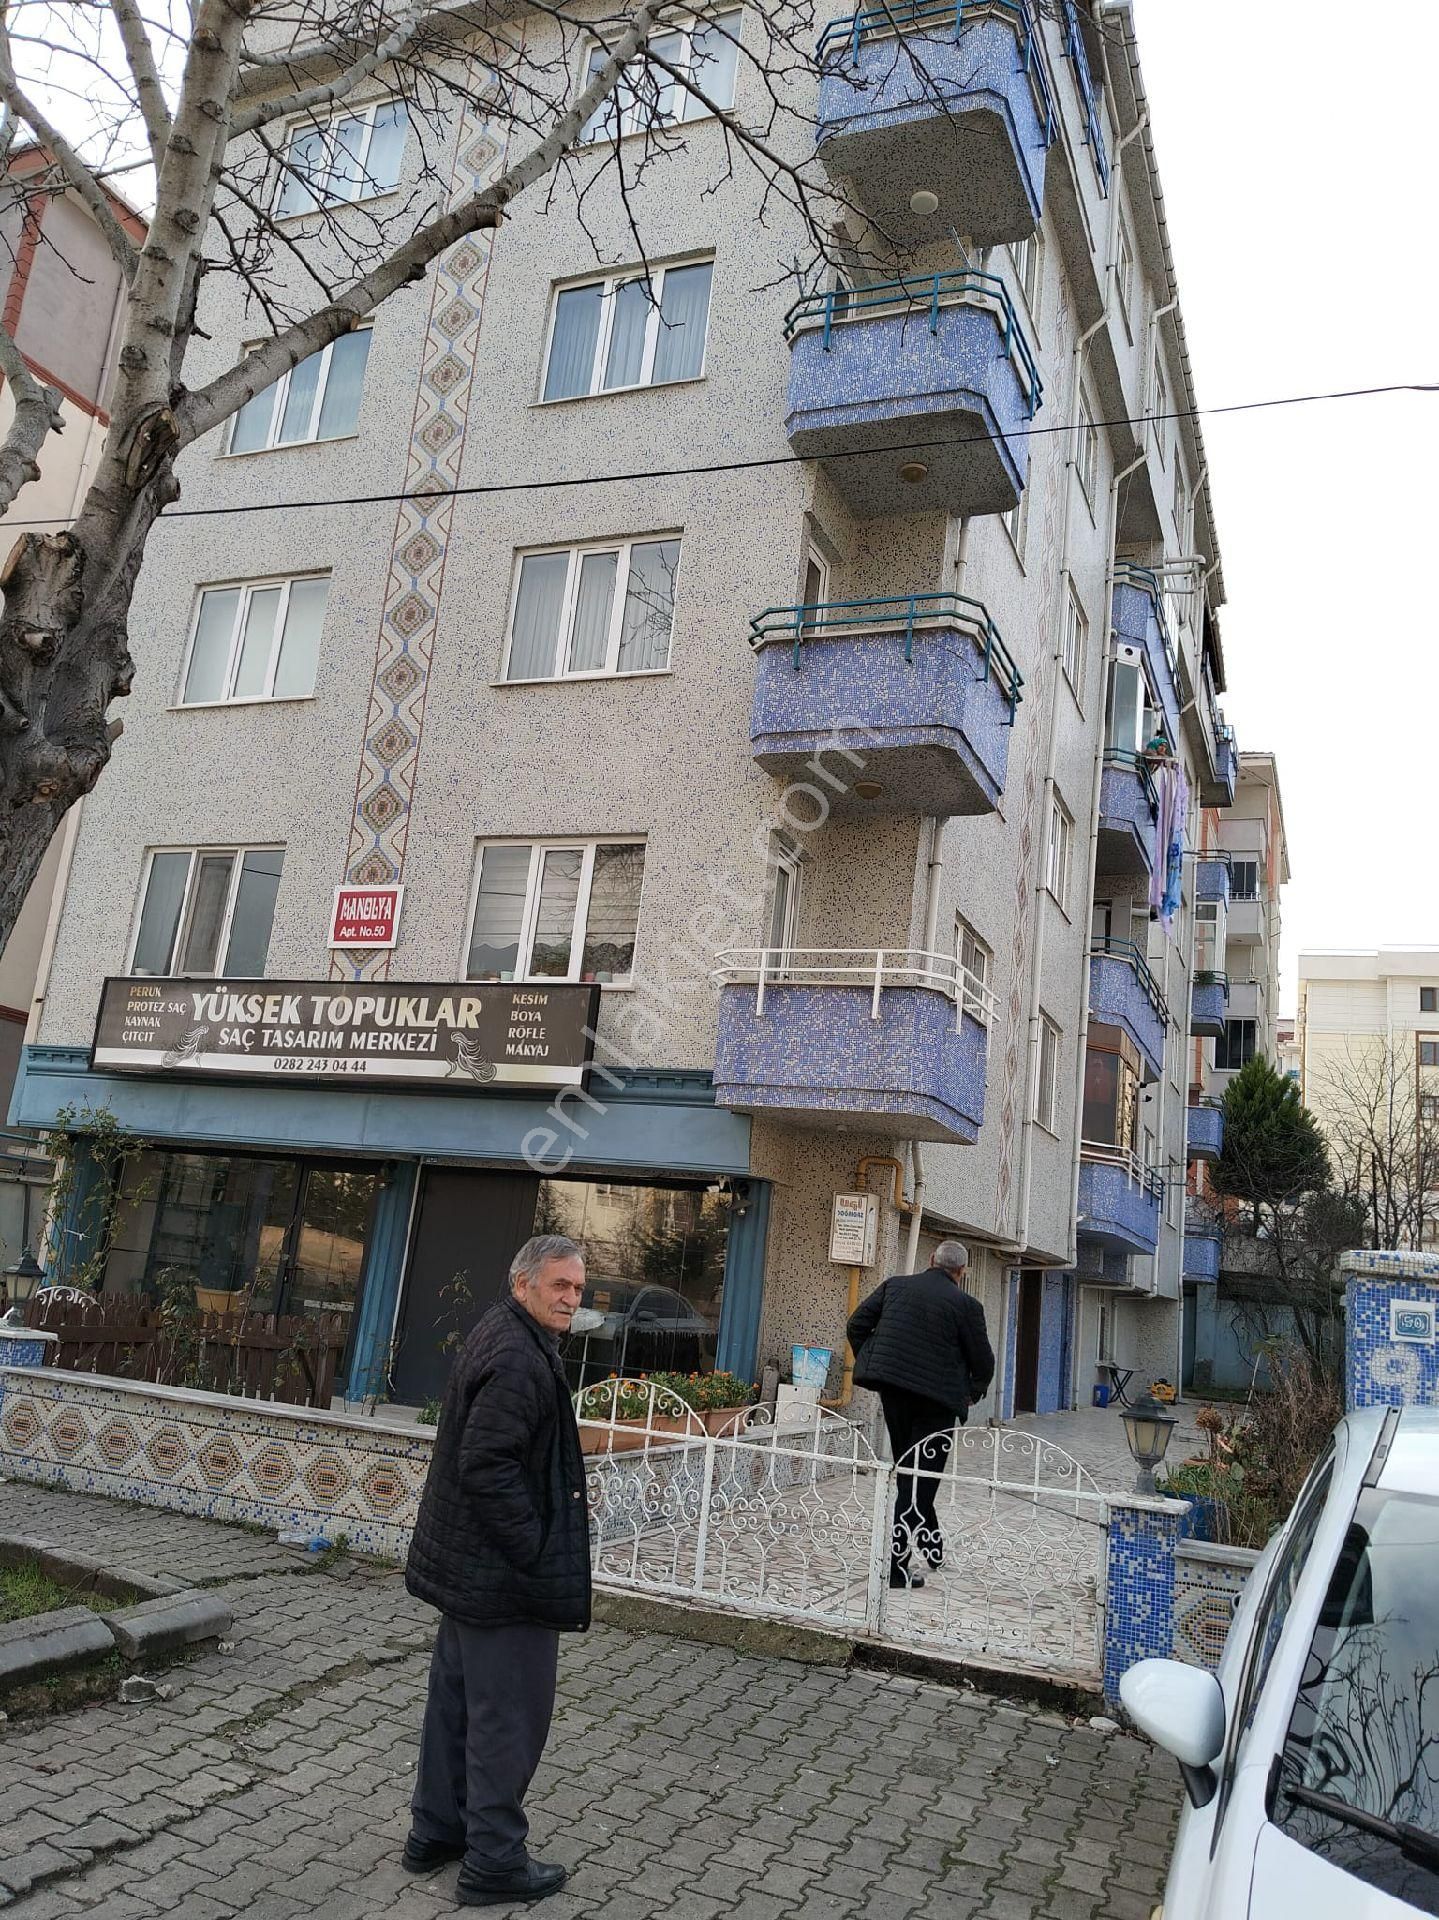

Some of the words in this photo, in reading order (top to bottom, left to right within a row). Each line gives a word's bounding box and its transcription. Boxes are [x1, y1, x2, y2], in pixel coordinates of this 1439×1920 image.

[339, 897, 392, 921] MANOLYA
[339, 926, 357, 938] Apt.
[360, 925, 386, 937] No.50
[130, 985, 162, 998] PERUK
[512, 991, 549, 1005] KESİM
[127, 1001, 165, 1013] PROTEZ
[167, 1002, 187, 1016] SAÇ
[192, 986, 303, 1025] YÜKSEK
[309, 995, 481, 1029] TOPUKLAR
[125, 1015, 161, 1028] KAYNAK
[511, 1010, 542, 1021] BOYA
[508, 1025, 547, 1039] RÖFLE
[218, 1028, 256, 1052] SAÇ
[261, 1029, 344, 1050] TASARIM
[349, 1028, 438, 1052] MERKEZİ
[505, 1043, 549, 1057] MAKYAJ
[273, 1057, 304, 1071] 0282
[332, 1059, 349, 1072] 04
[351, 1060, 367, 1073] 44
